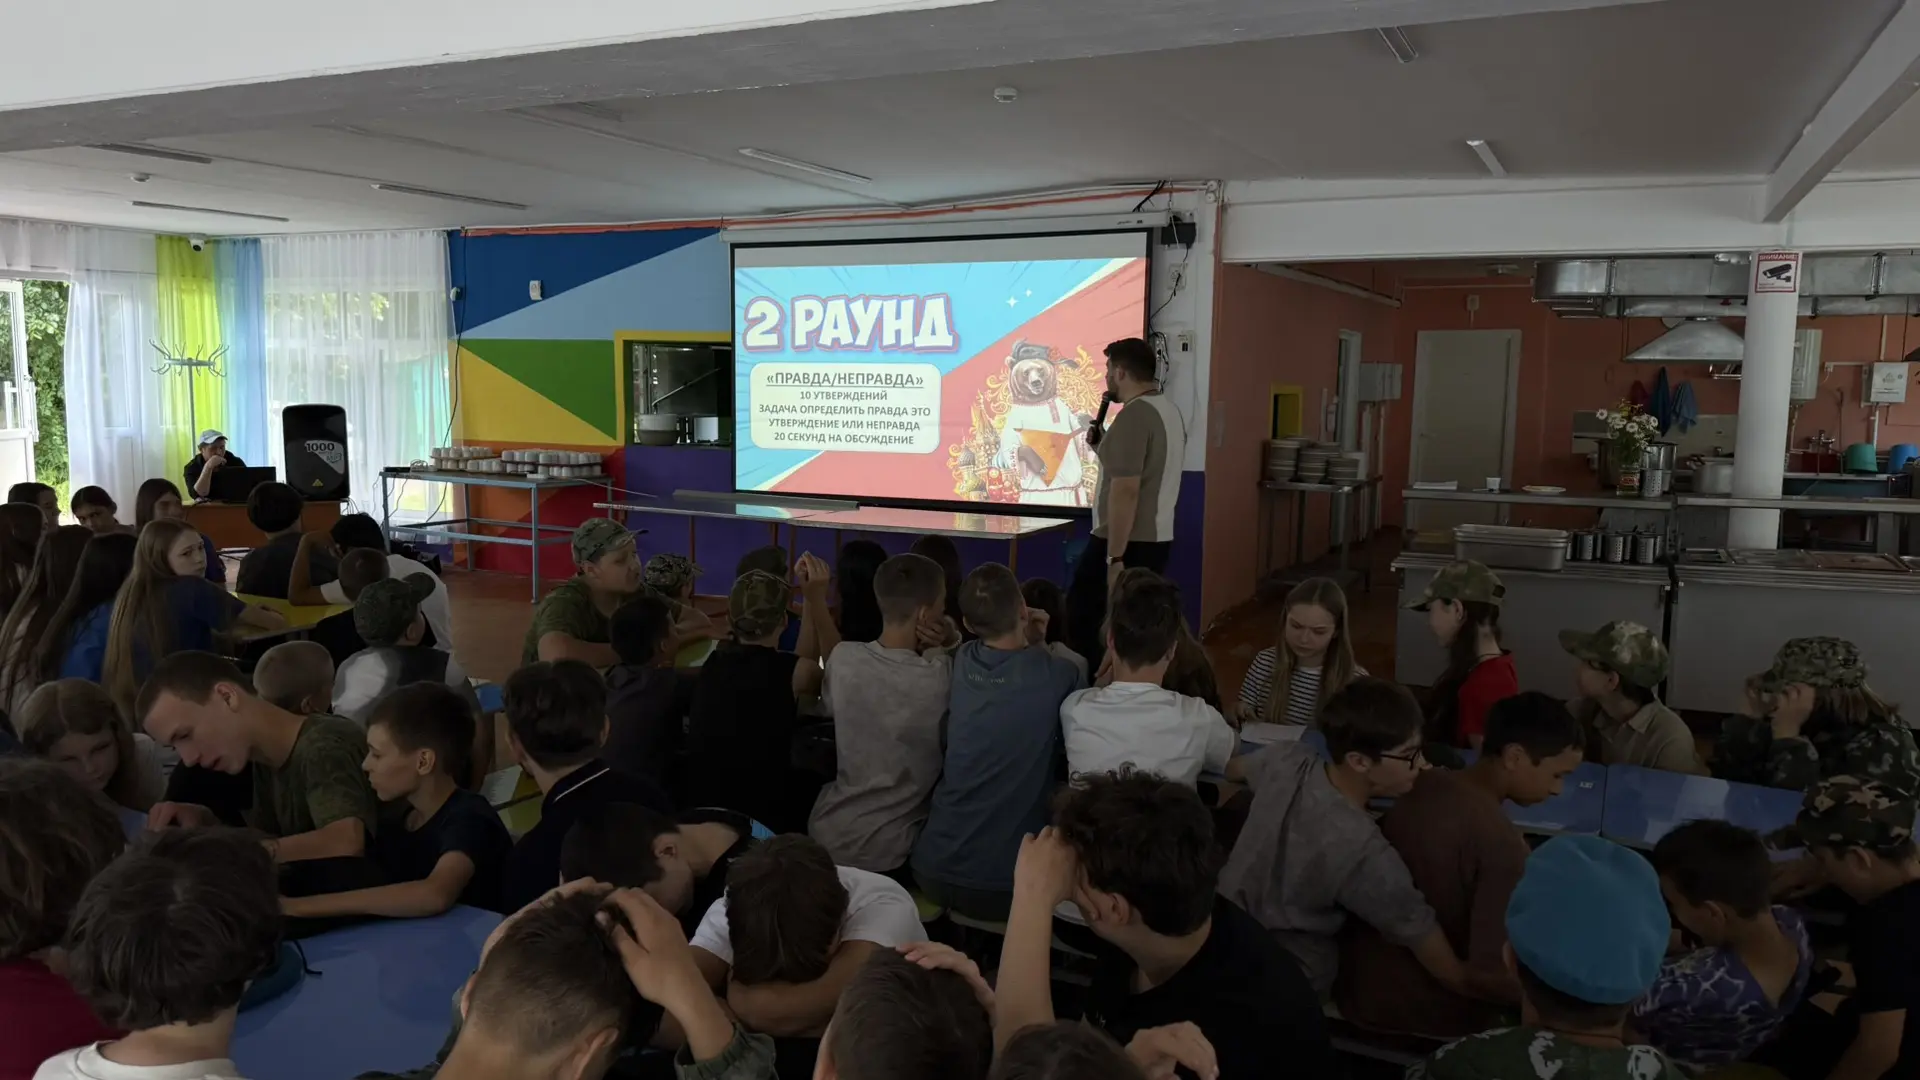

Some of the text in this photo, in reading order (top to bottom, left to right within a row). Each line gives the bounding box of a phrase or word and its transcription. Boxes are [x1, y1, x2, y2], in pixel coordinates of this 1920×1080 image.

[743, 295, 957, 351] 2 РАУНД
[766, 372, 924, 388] «ПРАВДА/НЕПРАВДА»
[800, 390, 888, 402] 10 УТВЕРЖДЕНИЙ
[759, 404, 931, 417] ЗАДАЧА ОПРЕДЕЛИТЬ ПРАВДА ЭТО
[768, 418, 921, 432] УТВЕРЖДЕНИЕ ИЛИ НЕПРАВДА
[774, 432, 915, 446] 20 СЕКУНД НА ОБСУЖДЕНИЕ
[306, 443, 334, 451] 1000
